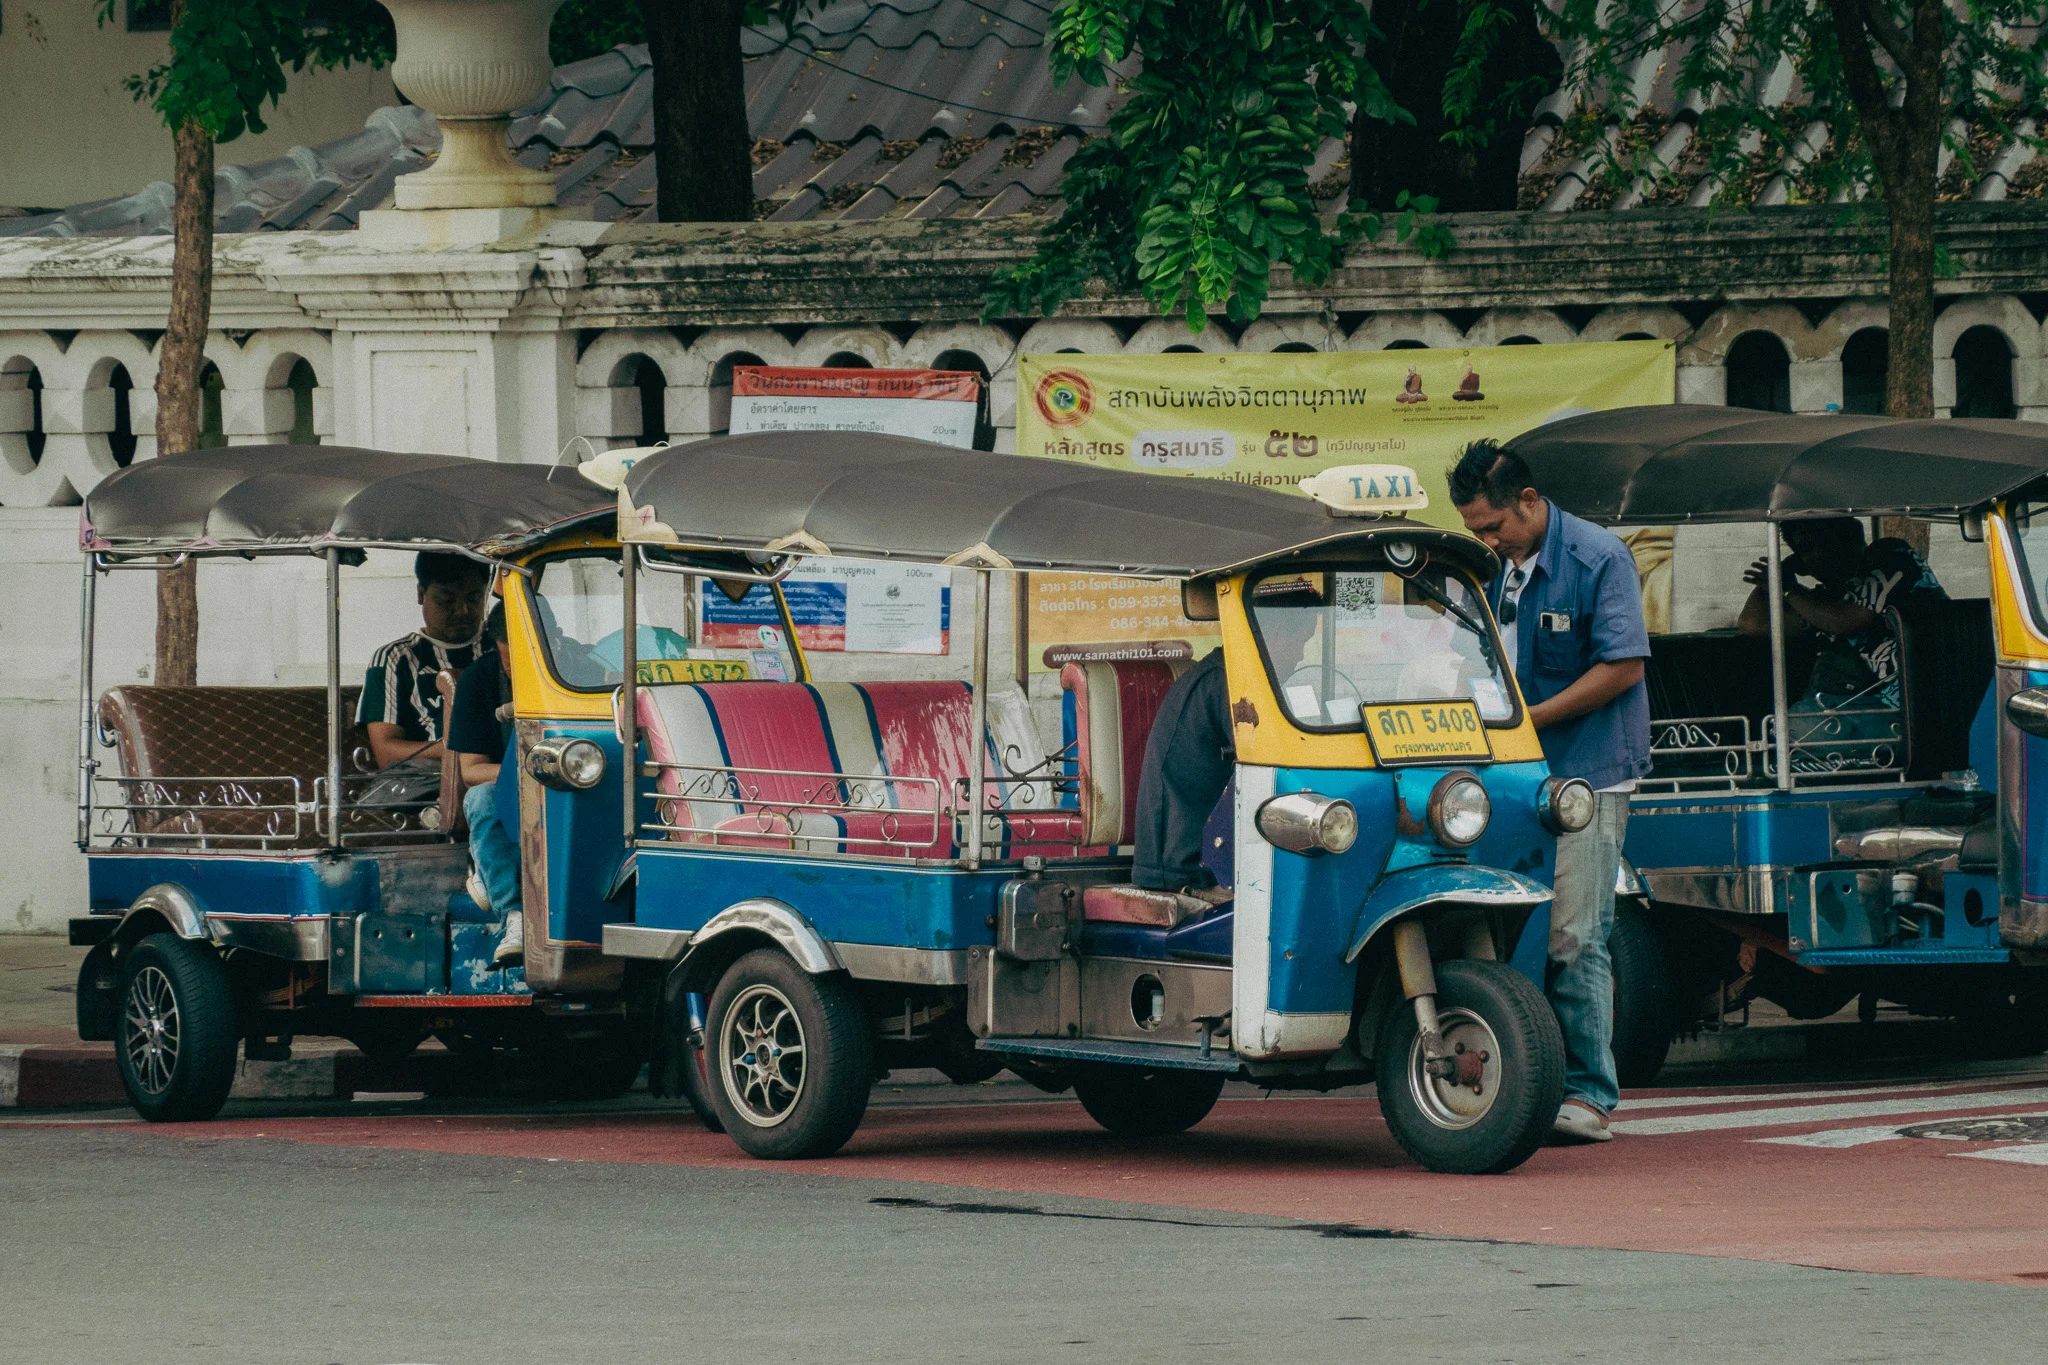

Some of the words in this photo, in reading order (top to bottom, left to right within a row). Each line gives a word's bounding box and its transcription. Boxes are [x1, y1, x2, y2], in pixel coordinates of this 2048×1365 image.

[1108, 385, 1367, 413] สถาบันพลังจิตตานุภาพ
[1044, 437, 1125, 461] หลักสูตร
[1142, 436, 1225, 463] ครูสมาธิ
[1242, 442, 1256, 455] รุ่น
[1263, 429, 1319, 458] ๕๒
[1349, 475, 1413, 499] TAXI
[1070, 579, 1087, 592] 30
[1108, 595, 1181, 610] 099-332-9
[1052, 647, 1183, 662] www.samathi101.com
[1378, 708, 1414, 736] สก
[1421, 708, 1477, 733] 5408
[1394, 741, 1472, 755] กรุงเทพมหานคร
